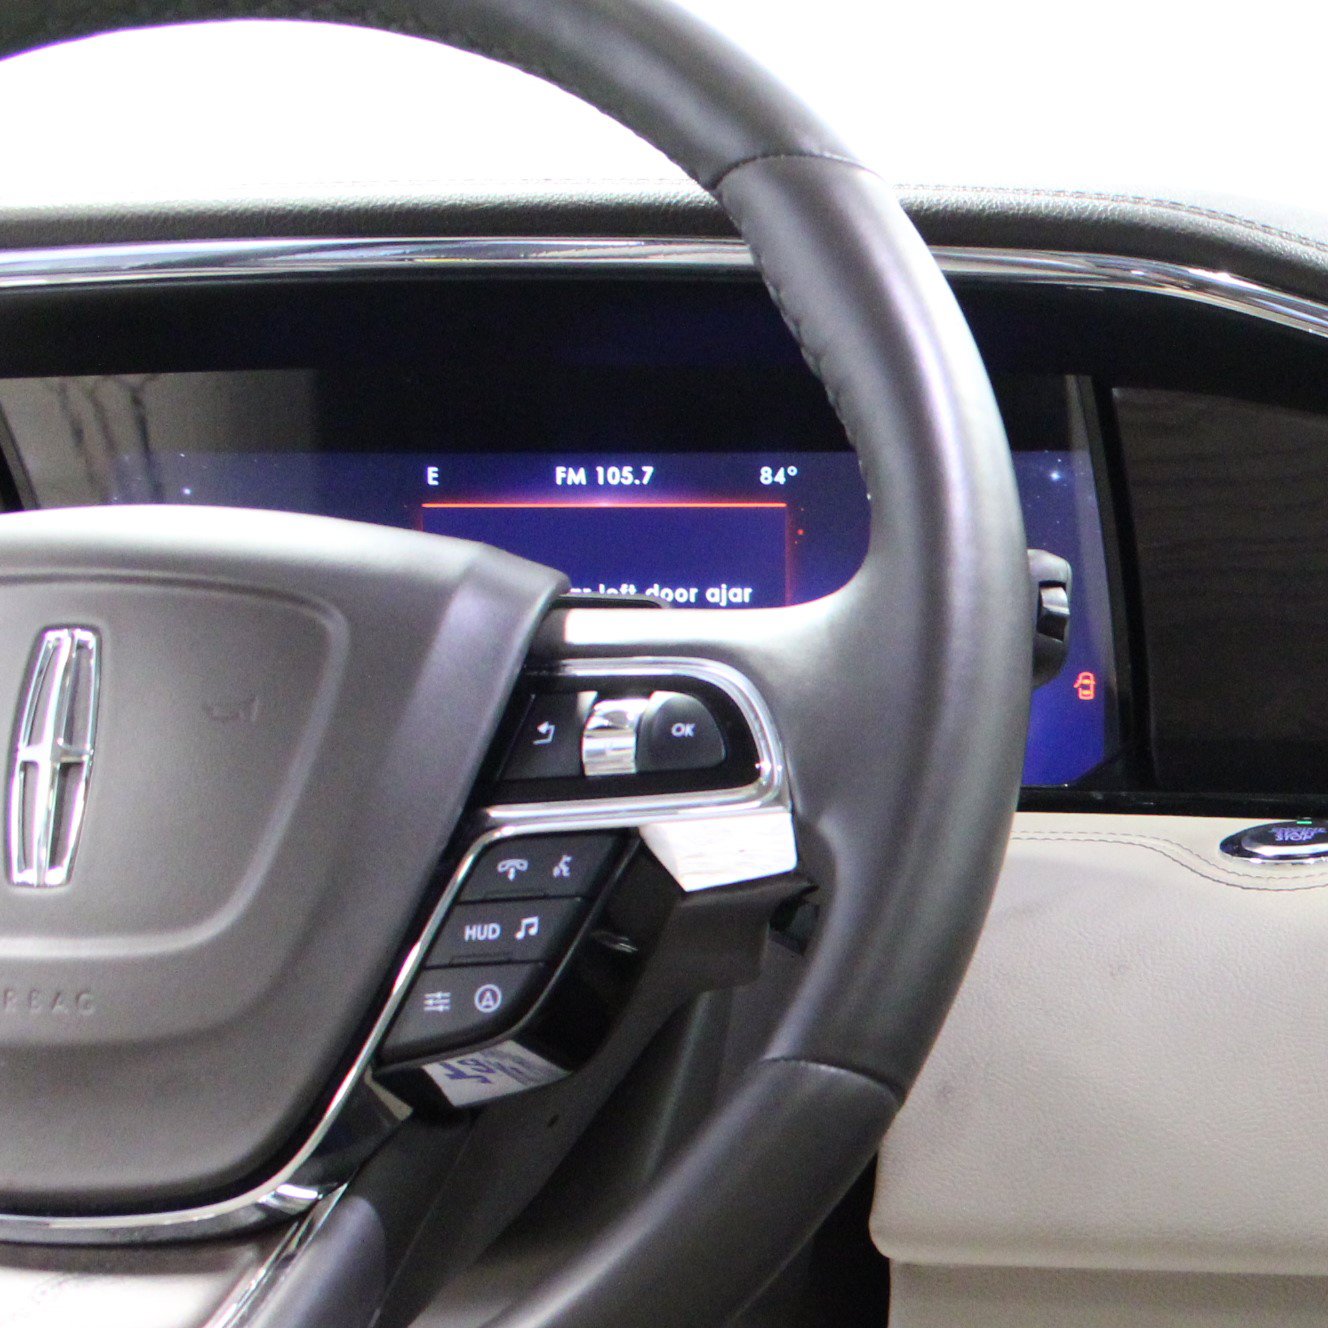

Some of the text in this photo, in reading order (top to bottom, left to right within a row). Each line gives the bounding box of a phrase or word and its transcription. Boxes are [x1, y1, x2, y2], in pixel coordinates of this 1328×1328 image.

[427, 467, 439, 485] E
[555, 467, 654, 485] FM 105.7
[705, 584, 752, 606] ajar
[671, 722, 694, 738] OK
[464, 924, 501, 940] HUD
